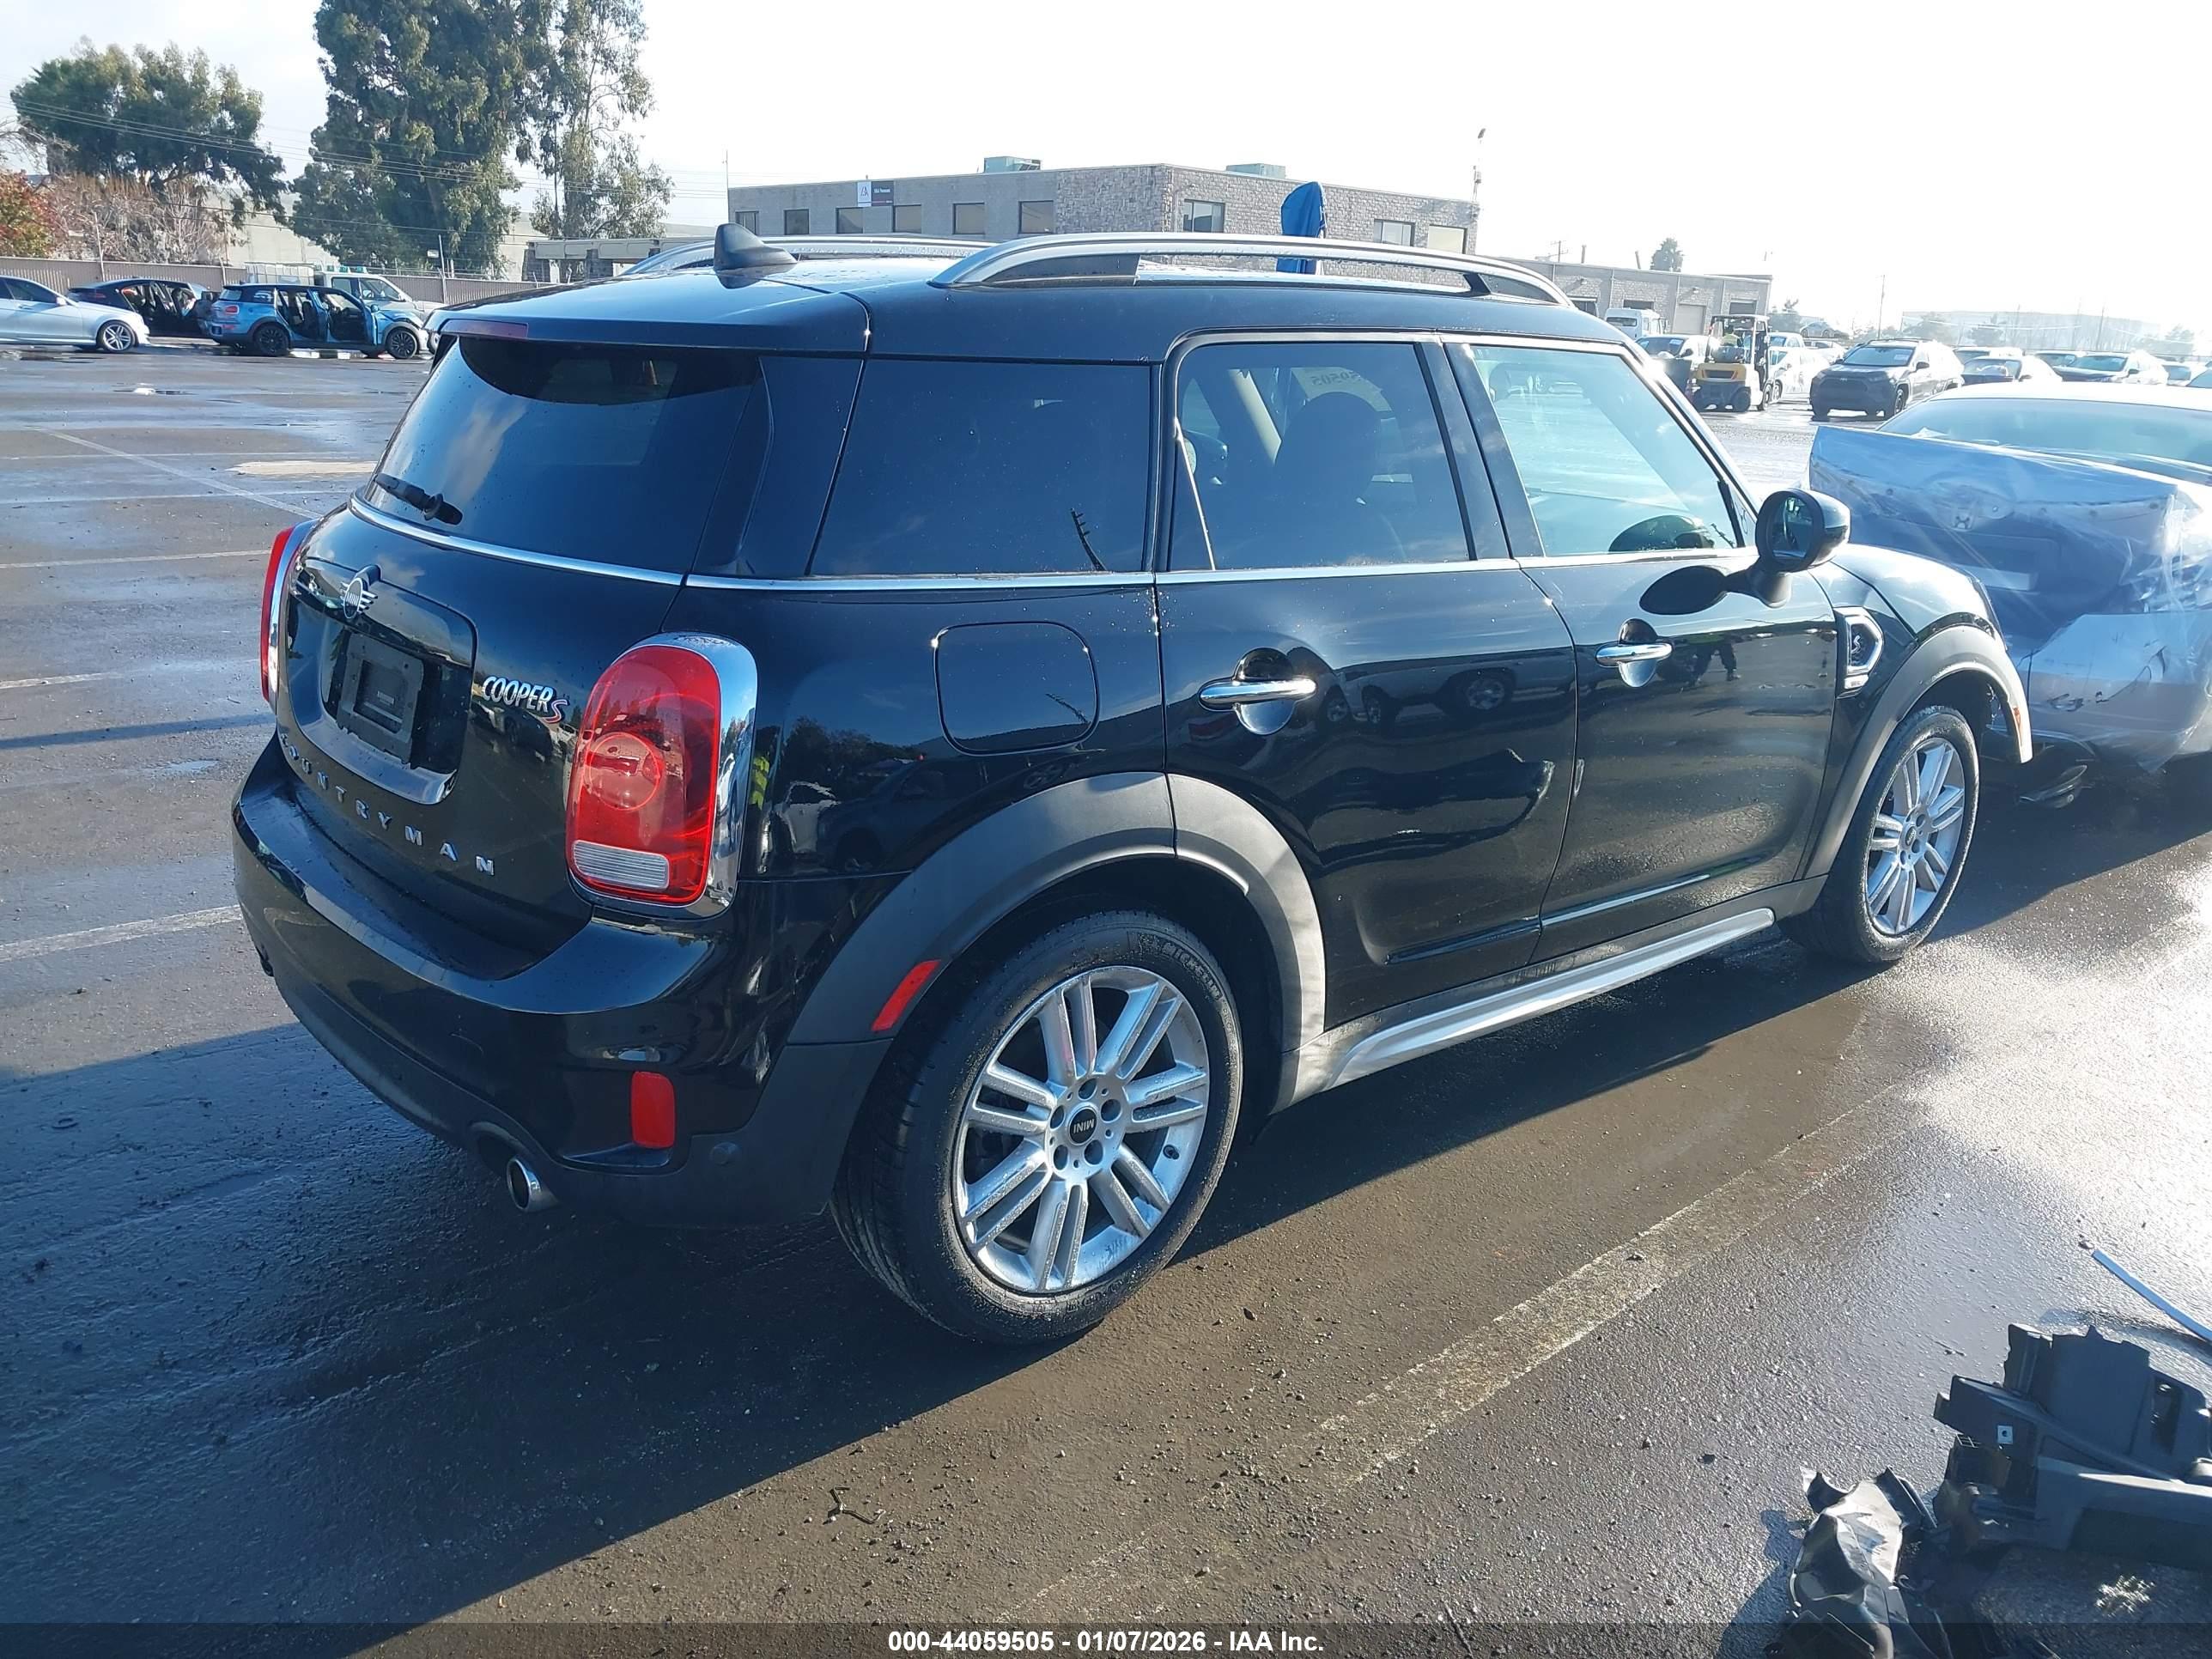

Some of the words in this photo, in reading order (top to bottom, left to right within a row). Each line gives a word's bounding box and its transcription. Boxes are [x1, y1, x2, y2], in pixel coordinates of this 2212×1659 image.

[482, 676, 555, 713] COOPER
[542, 699, 568, 724] S
[281, 732, 495, 877] COUNTRYMAN
[1162, 942, 1223, 1001] MICHELIN
[1073, 1118, 1095, 1134] MINI
